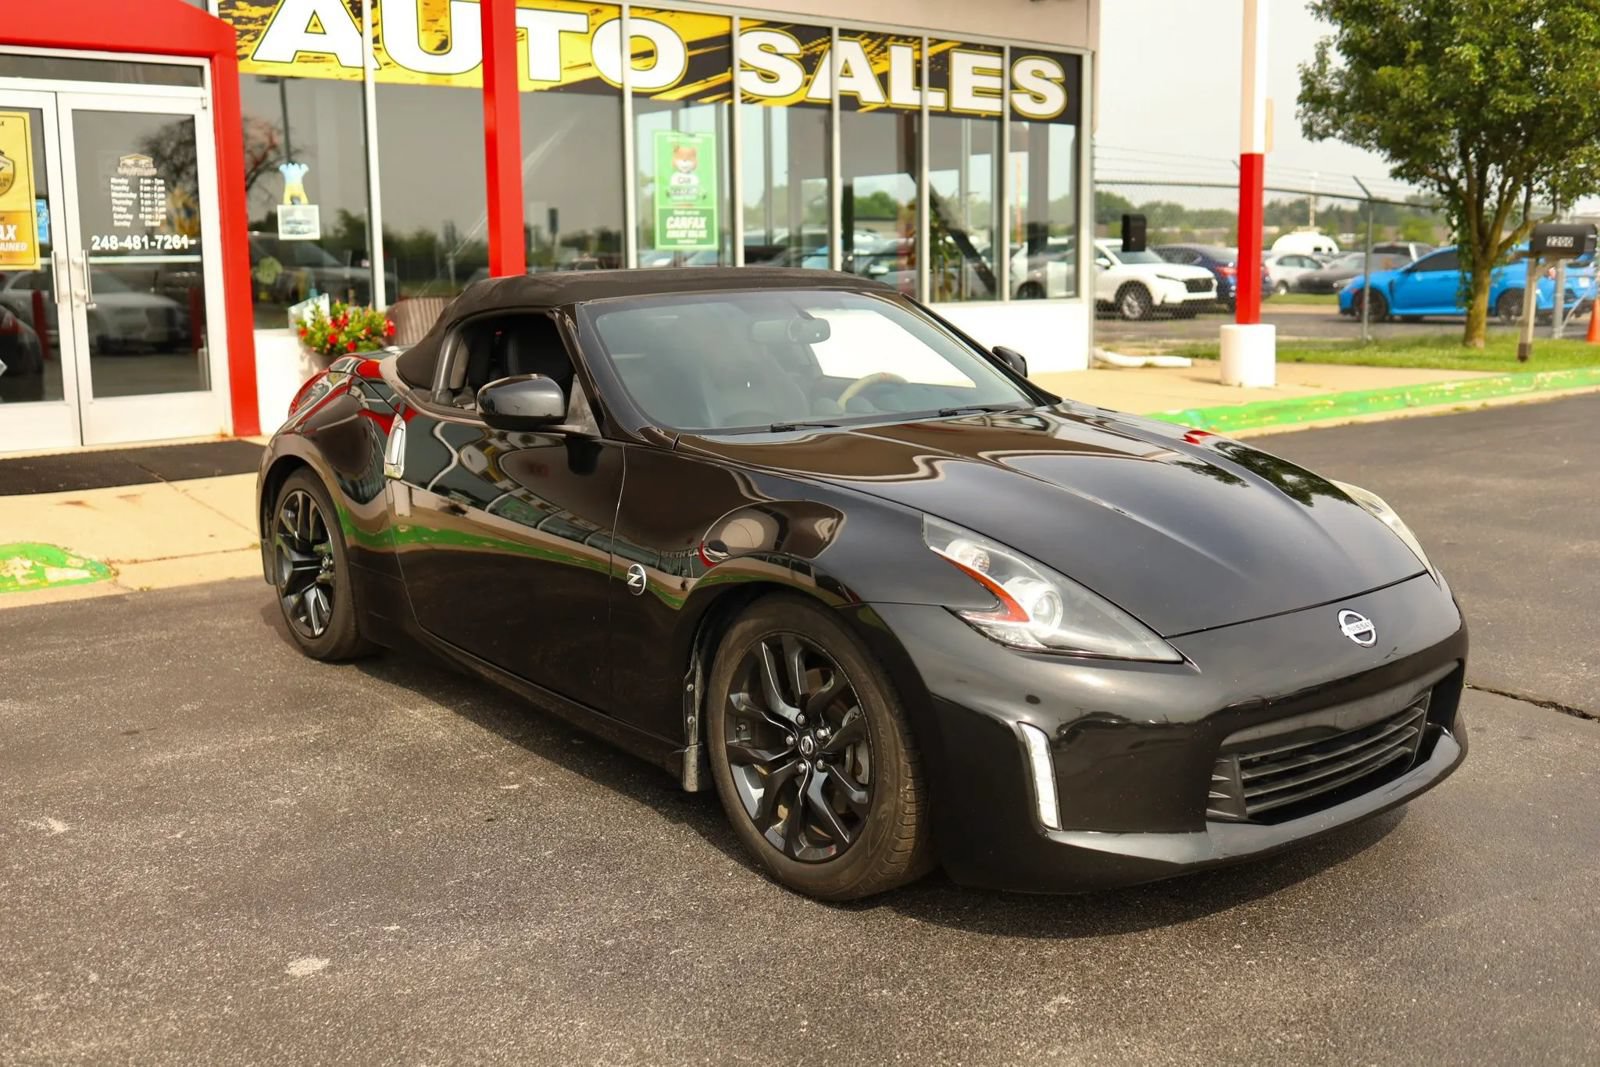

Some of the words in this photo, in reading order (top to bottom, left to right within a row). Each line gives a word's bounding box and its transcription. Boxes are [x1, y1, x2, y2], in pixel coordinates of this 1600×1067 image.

[250, 0, 687, 91] AUTO
[737, 28, 1068, 119] SALES
[666, 216, 707, 230] CARFAX
